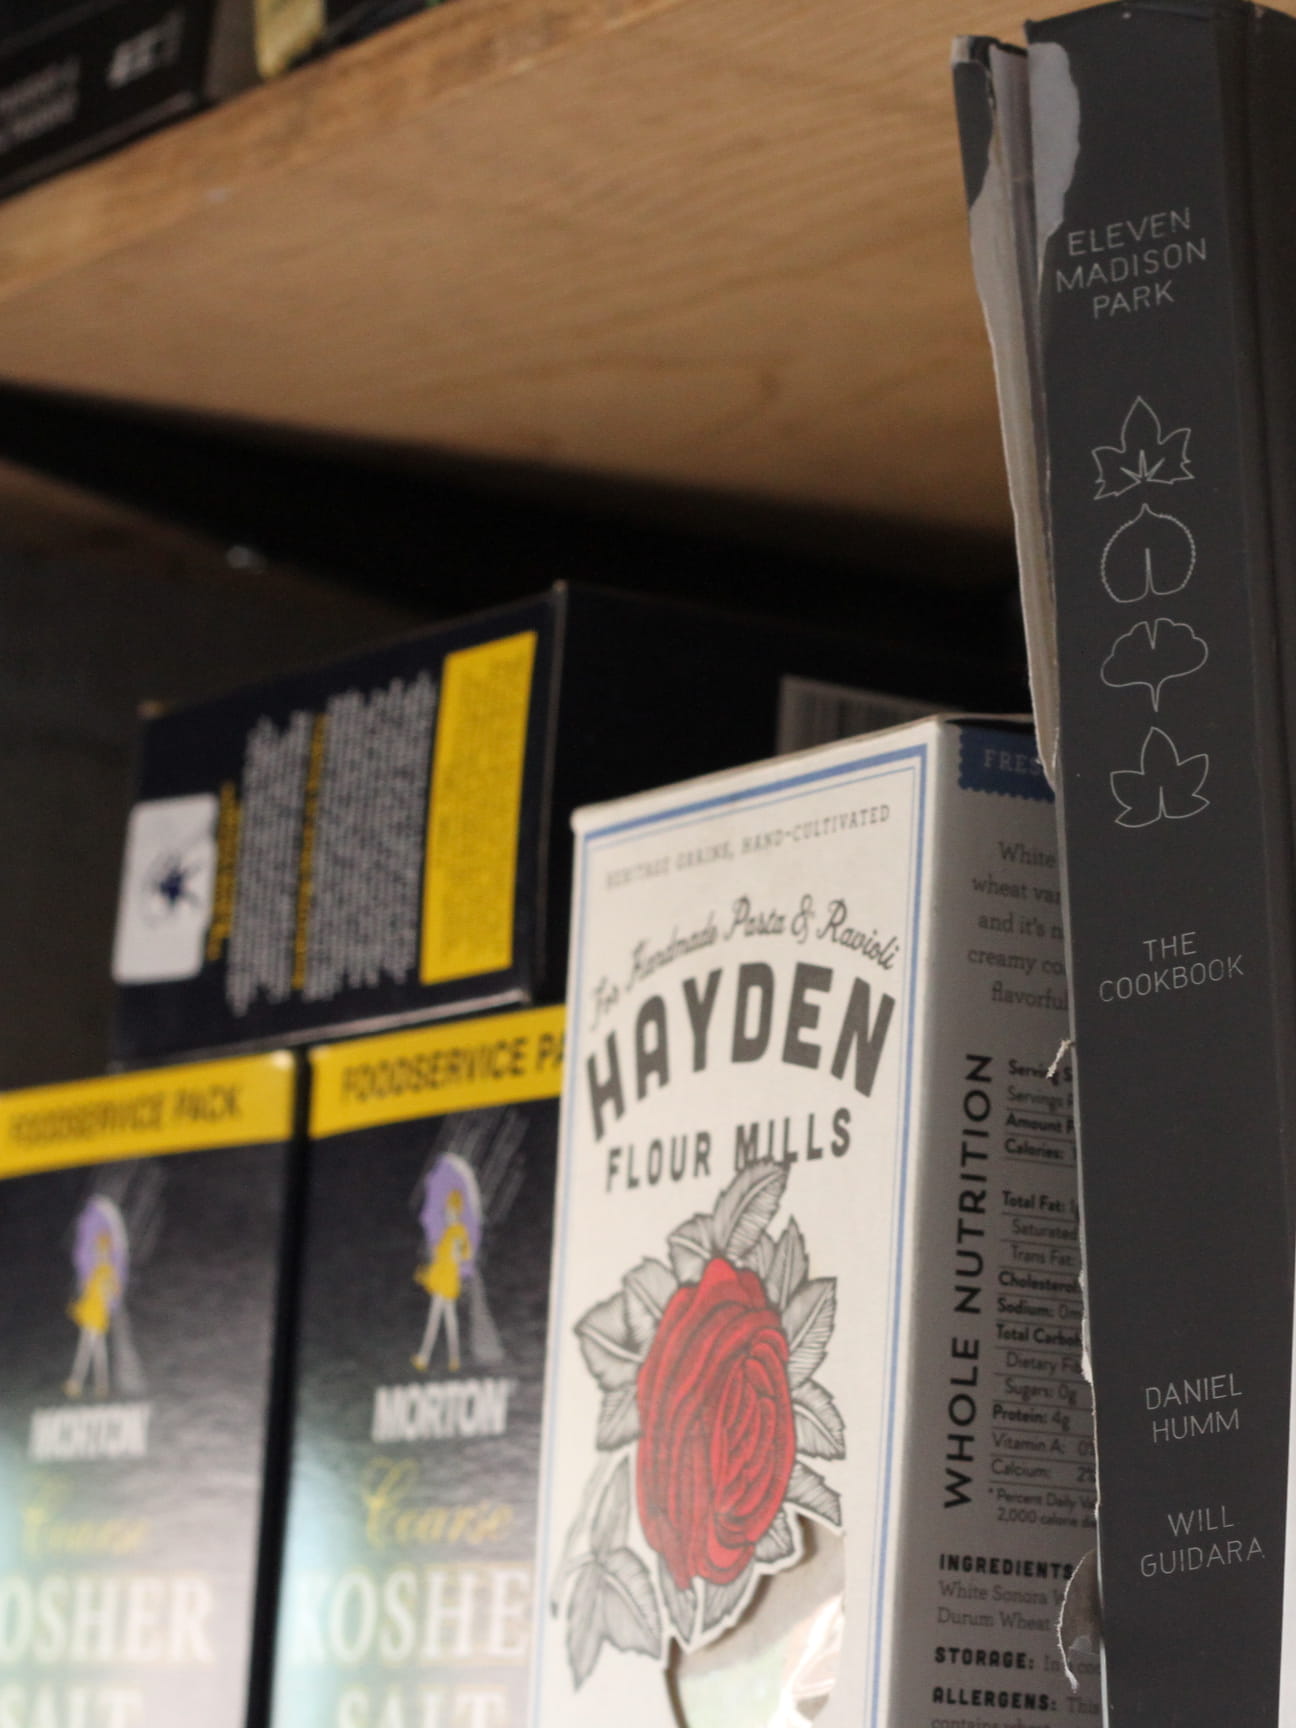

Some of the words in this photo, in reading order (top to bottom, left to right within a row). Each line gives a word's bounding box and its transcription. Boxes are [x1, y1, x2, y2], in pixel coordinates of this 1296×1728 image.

[1068, 206, 1191, 257] ELEVEN
[1055, 237, 1207, 294] MADISON
[1092, 279, 1176, 320] PARK
[997, 842, 1057, 868] White
[971, 874, 1029, 901] wheat
[723, 893, 786, 942] Pasta
[791, 893, 816, 945] &
[816, 896, 902, 971] Ravioli
[977, 912, 1015, 934] and
[967, 948, 1037, 976] creamy
[1142, 931, 1198, 962] THE
[1099, 954, 1245, 1003] COOKBOOK
[342, 1036, 527, 1106] FOODSERVICE
[586, 961, 896, 1143] HAYDEN
[1005, 1112, 1062, 1134] Amount
[605, 1131, 712, 1193] FLOUR
[733, 1107, 852, 1172] MILLS
[953, 1053, 994, 1314] NUTRITION
[1002, 1190, 1036, 1209] Total
[996, 1323, 1029, 1341] Total
[1032, 1327, 1083, 1348] Carboh
[1145, 1373, 1243, 1411] DANIEL
[372, 1381, 512, 1443] MORTON
[944, 1336, 980, 1509] WHOLE
[992, 1403, 1048, 1425] Protein:
[1152, 1407, 1240, 1444] HUMM
[991, 1432, 1046, 1451] Vitamin
[1167, 1505, 1236, 1537] WILL
[1140, 1536, 1266, 1578] GUIDARA
[0, 1571, 215, 1665] OSHER
[294, 1564, 531, 1667] KOSHE
[934, 1646, 1035, 1670] STORAGE:
[932, 1686, 1057, 1712] ALLERGENS:
